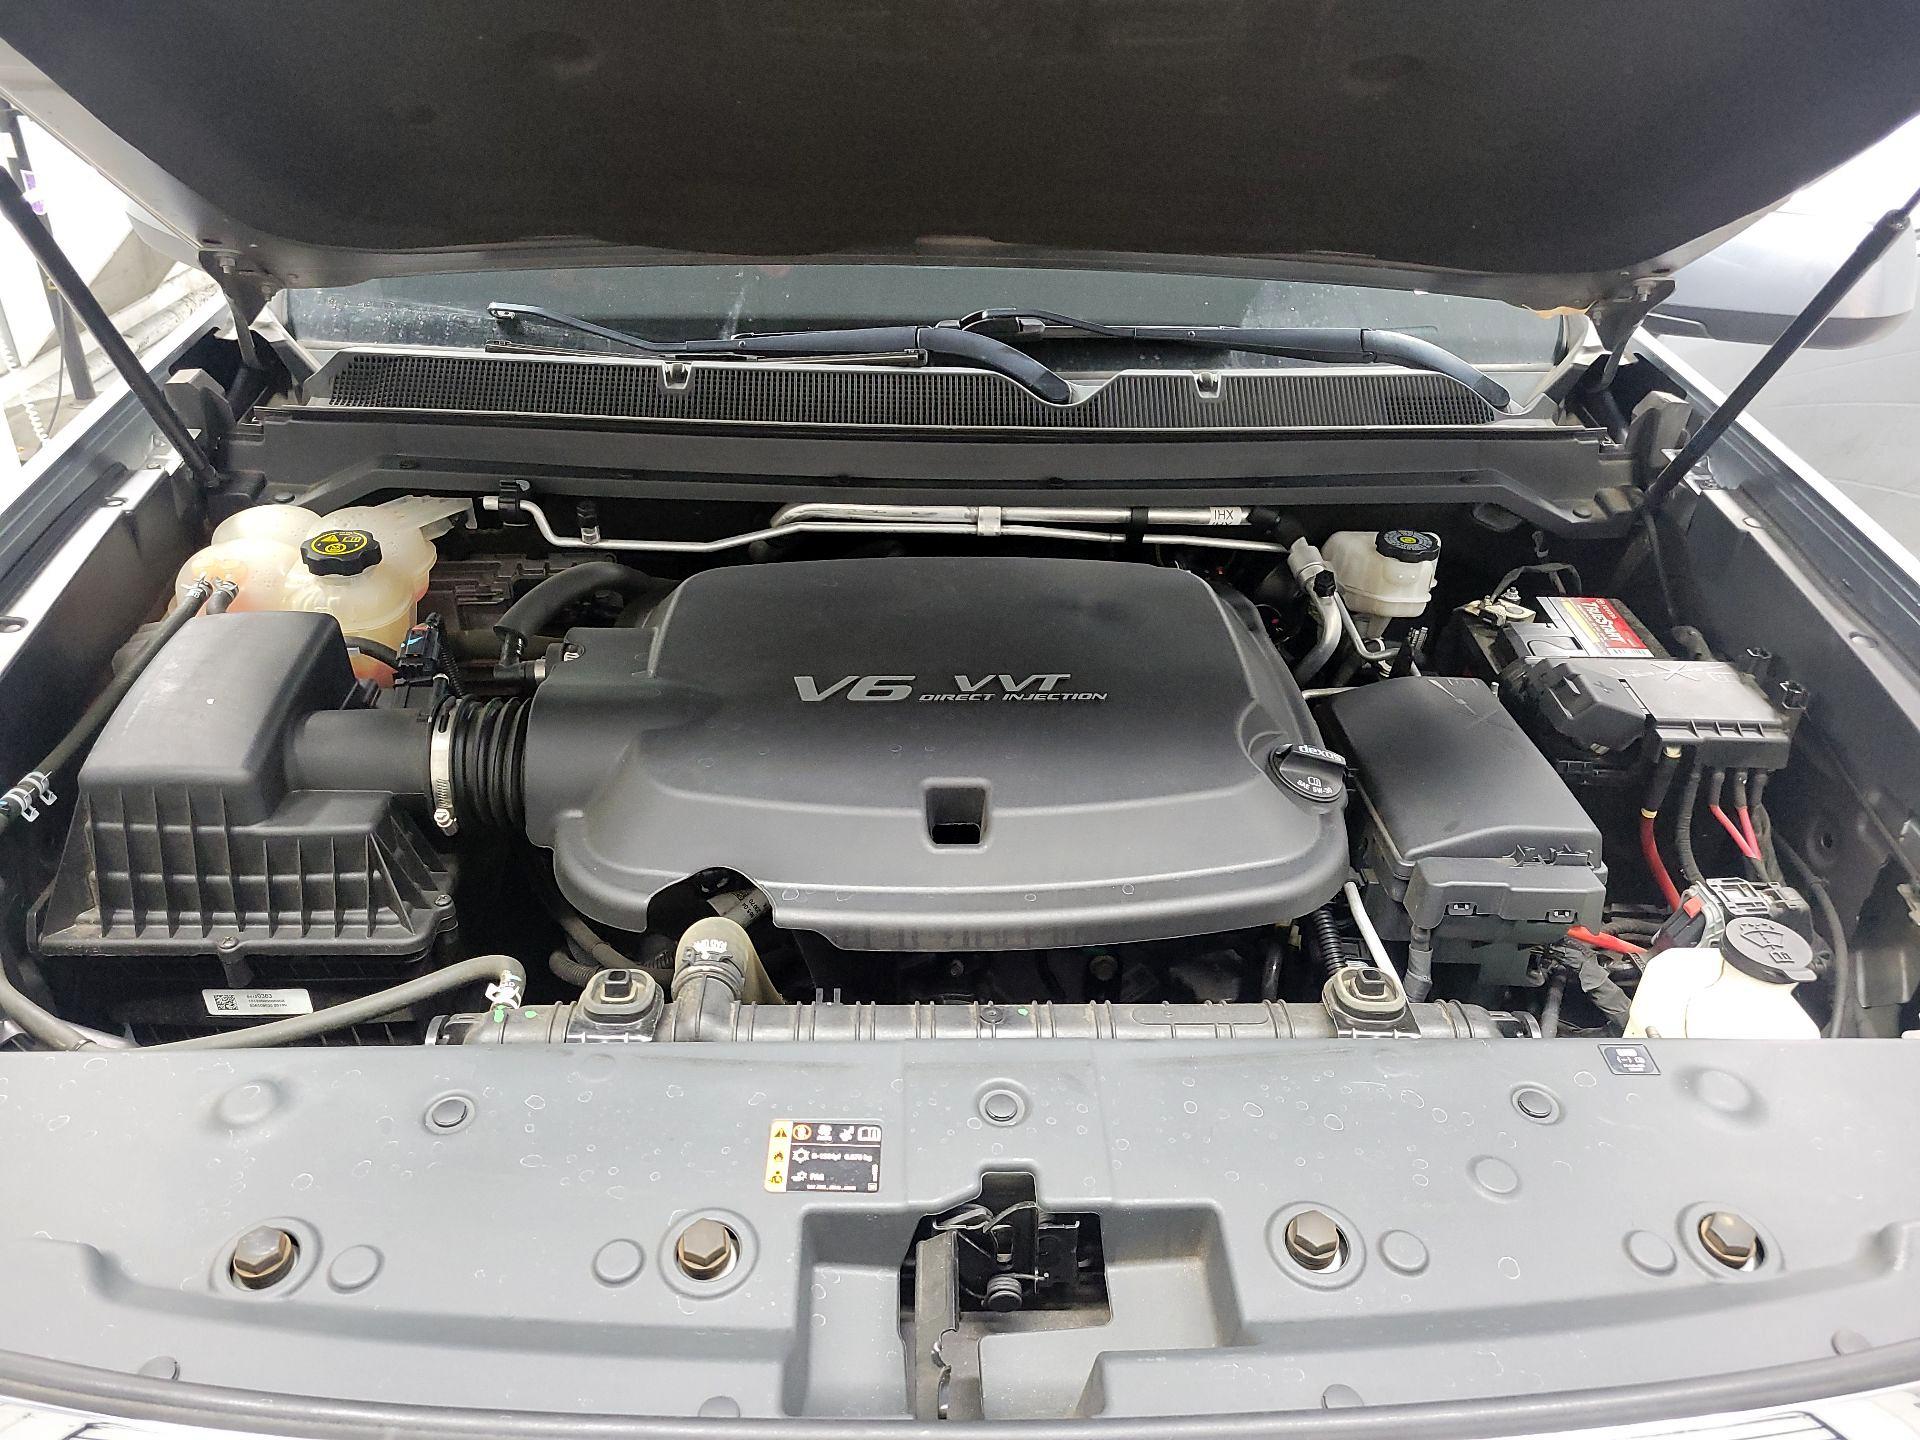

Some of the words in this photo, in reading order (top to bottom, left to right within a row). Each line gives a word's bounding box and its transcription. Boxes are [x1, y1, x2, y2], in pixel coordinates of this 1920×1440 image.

[794, 675, 916, 702] V6
[954, 674, 1071, 692] VVT
[918, 693, 997, 701] DIRECT
[1001, 692, 1108, 701] INJECTION
